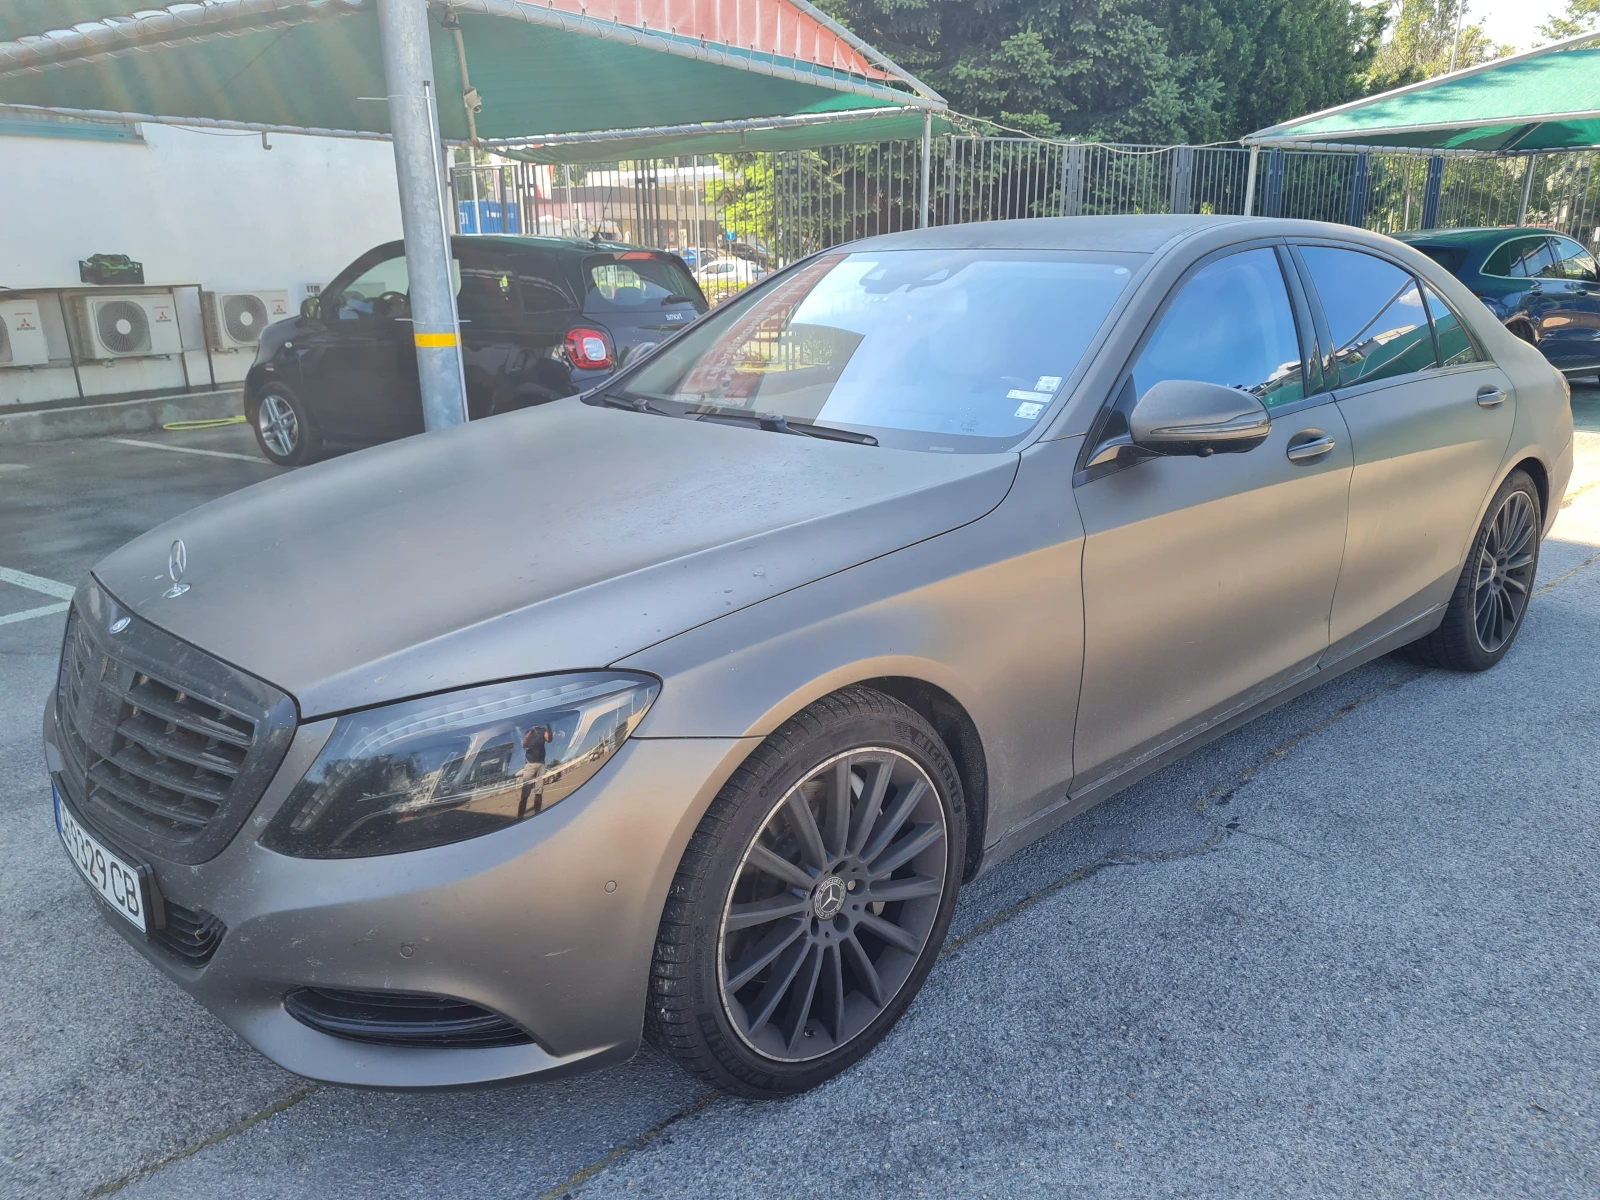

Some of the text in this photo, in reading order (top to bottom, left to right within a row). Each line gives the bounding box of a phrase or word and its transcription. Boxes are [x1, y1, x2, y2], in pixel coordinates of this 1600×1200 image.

[665, 312, 683, 321] smart
[914, 731, 962, 809] MICHELIN
[110, 861, 140, 918] CB
[701, 1016, 772, 1087] MICHELIN
